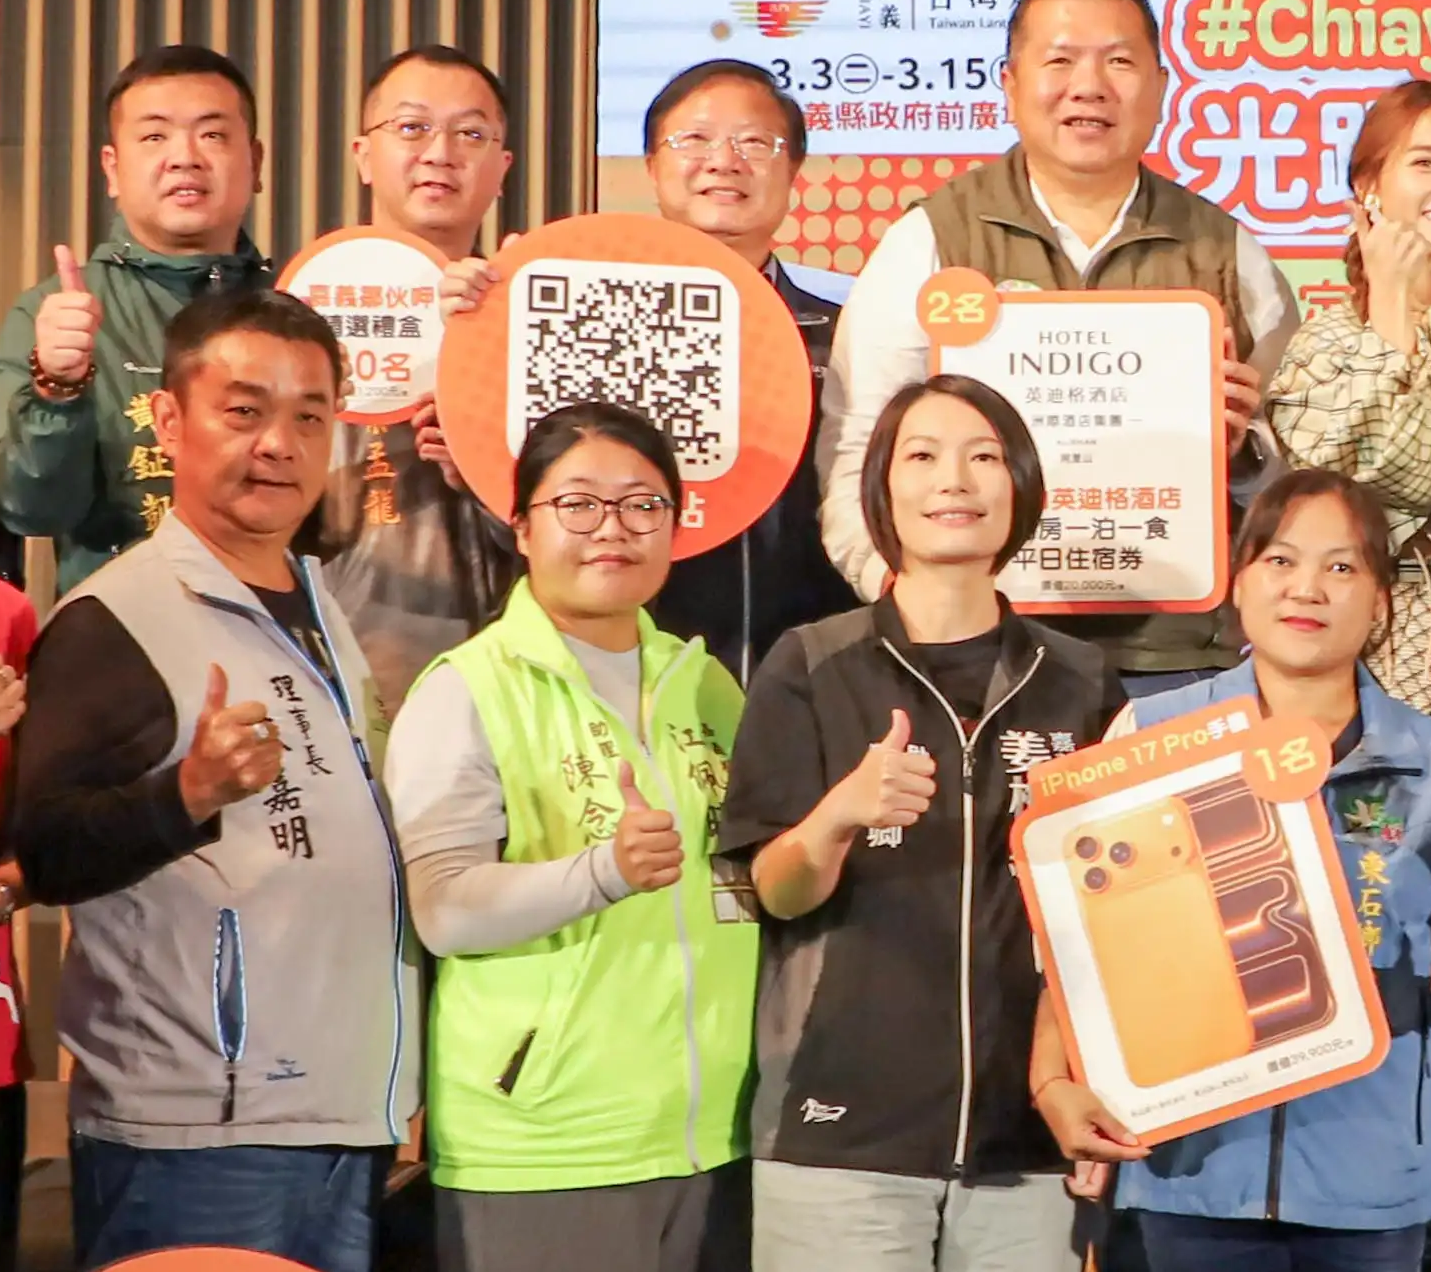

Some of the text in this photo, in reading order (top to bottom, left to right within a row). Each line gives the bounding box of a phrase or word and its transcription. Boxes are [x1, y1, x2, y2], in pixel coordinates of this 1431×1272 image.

[928, 16, 975, 29] Taiwan
[926, 290, 986, 324] 2名
[1038, 330, 1113, 345] HOTEL
[1008, 351, 1143, 376] INDIGO
[1024, 386, 1129, 405] 英迪格酒店
[1042, 486, 1183, 511] 英迪格酒店
[1026, 516, 1170, 543] 房一泊一食
[1010, 546, 1145, 572] 平日住宿券
[269, 674, 335, 776] 理事長
[1040, 756, 1128, 798] iPhone
[1129, 738, 1159, 766] 17
[1253, 735, 1317, 782] 1名
